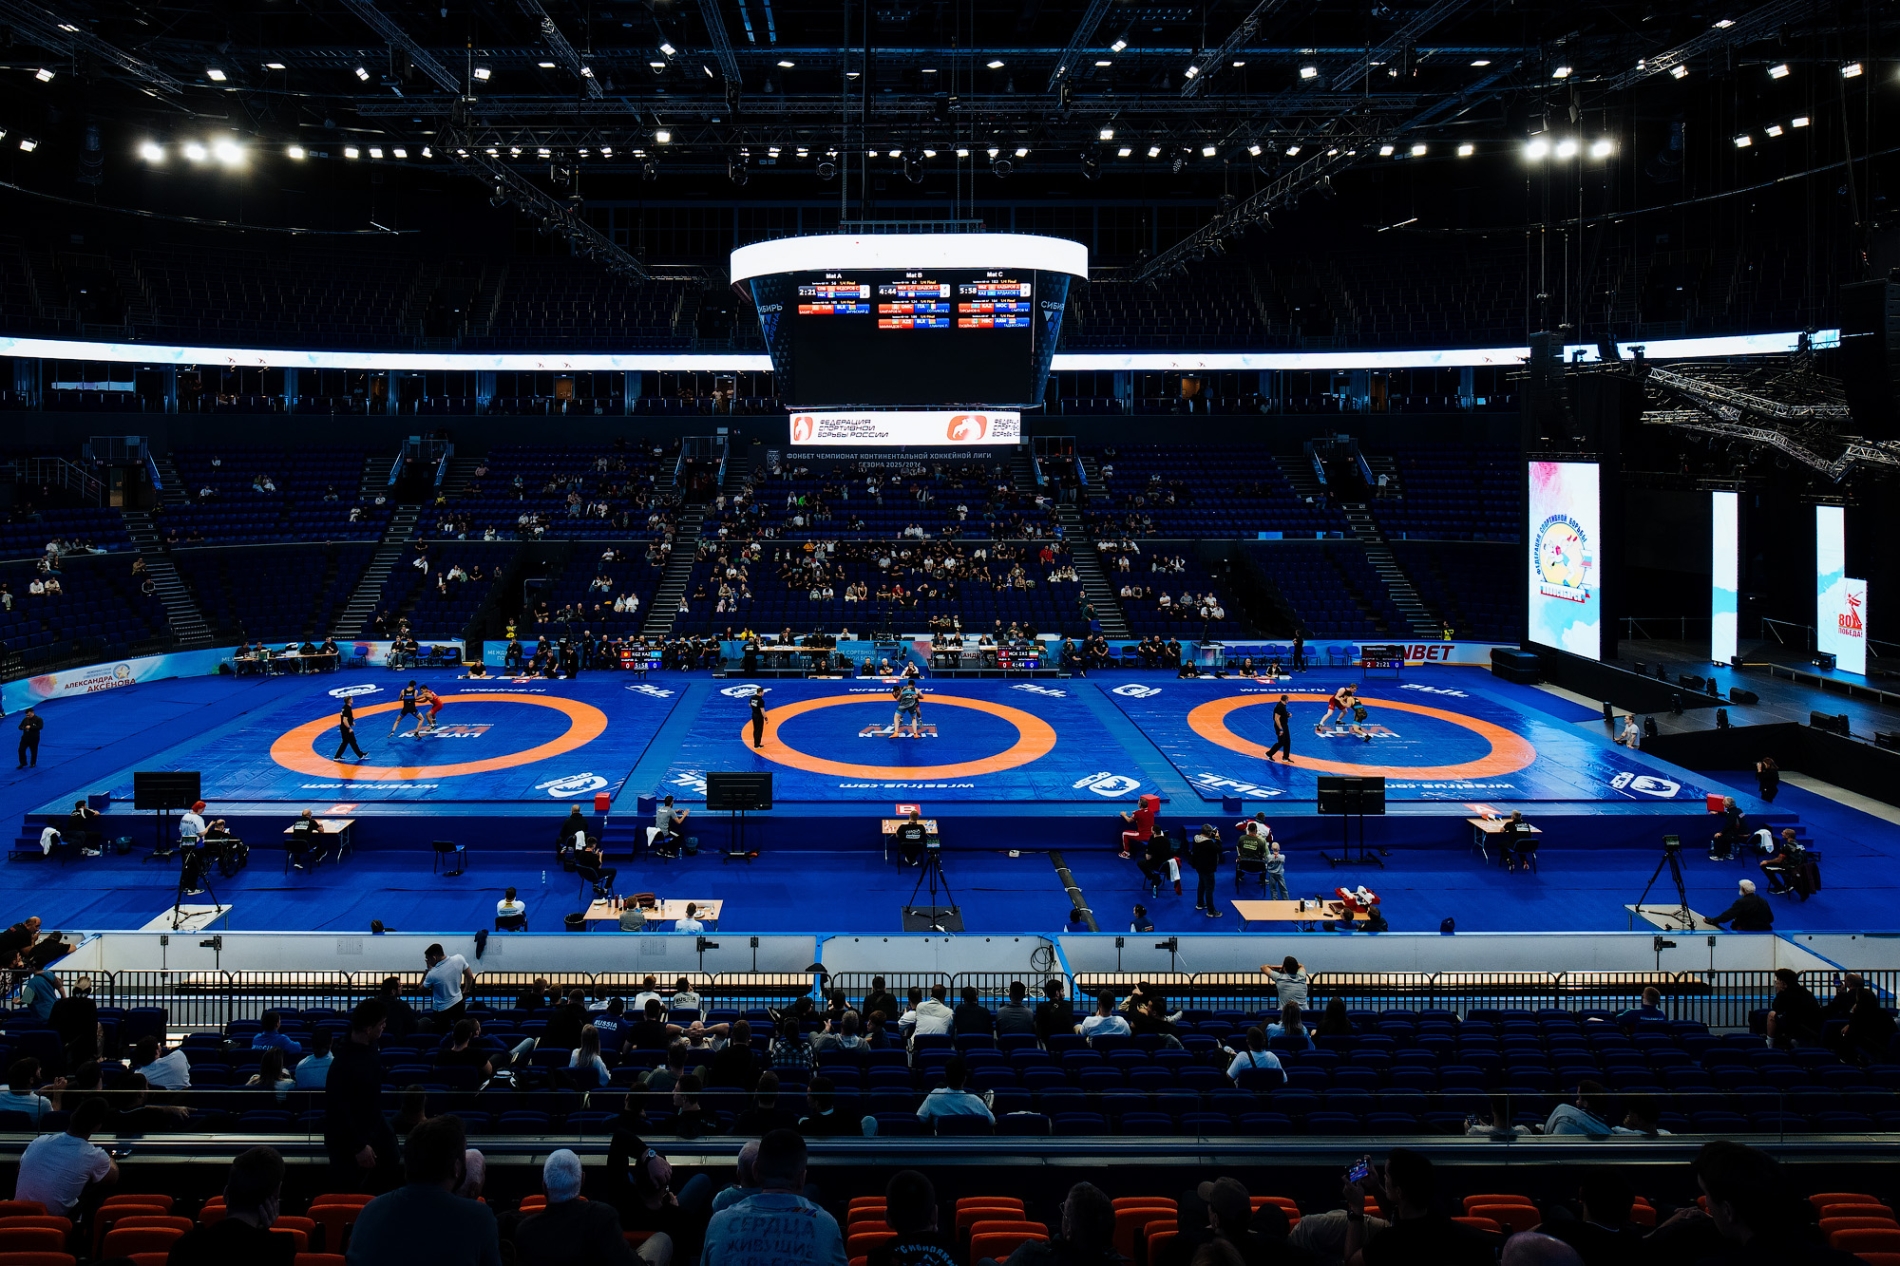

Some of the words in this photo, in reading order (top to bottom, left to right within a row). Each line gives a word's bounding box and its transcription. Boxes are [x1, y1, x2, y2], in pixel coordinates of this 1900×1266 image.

[1540, 514, 1568, 533] СПОРТИВНОЙ
[1569, 517, 1587, 542] БОРЬБЫ
[1839, 613, 1851, 627] 80
[1838, 628, 1862, 638] ПОБЕДА!
[64, 675, 113, 689] АЛЕКСАНДРА
[87, 678, 136, 692] АКСЕНОВА
[594, 1019, 618, 1028] RUSSIA
[726, 1216, 815, 1238] СЕРДЦА
[726, 1238, 814, 1258] ЖИВУЩИЕ
